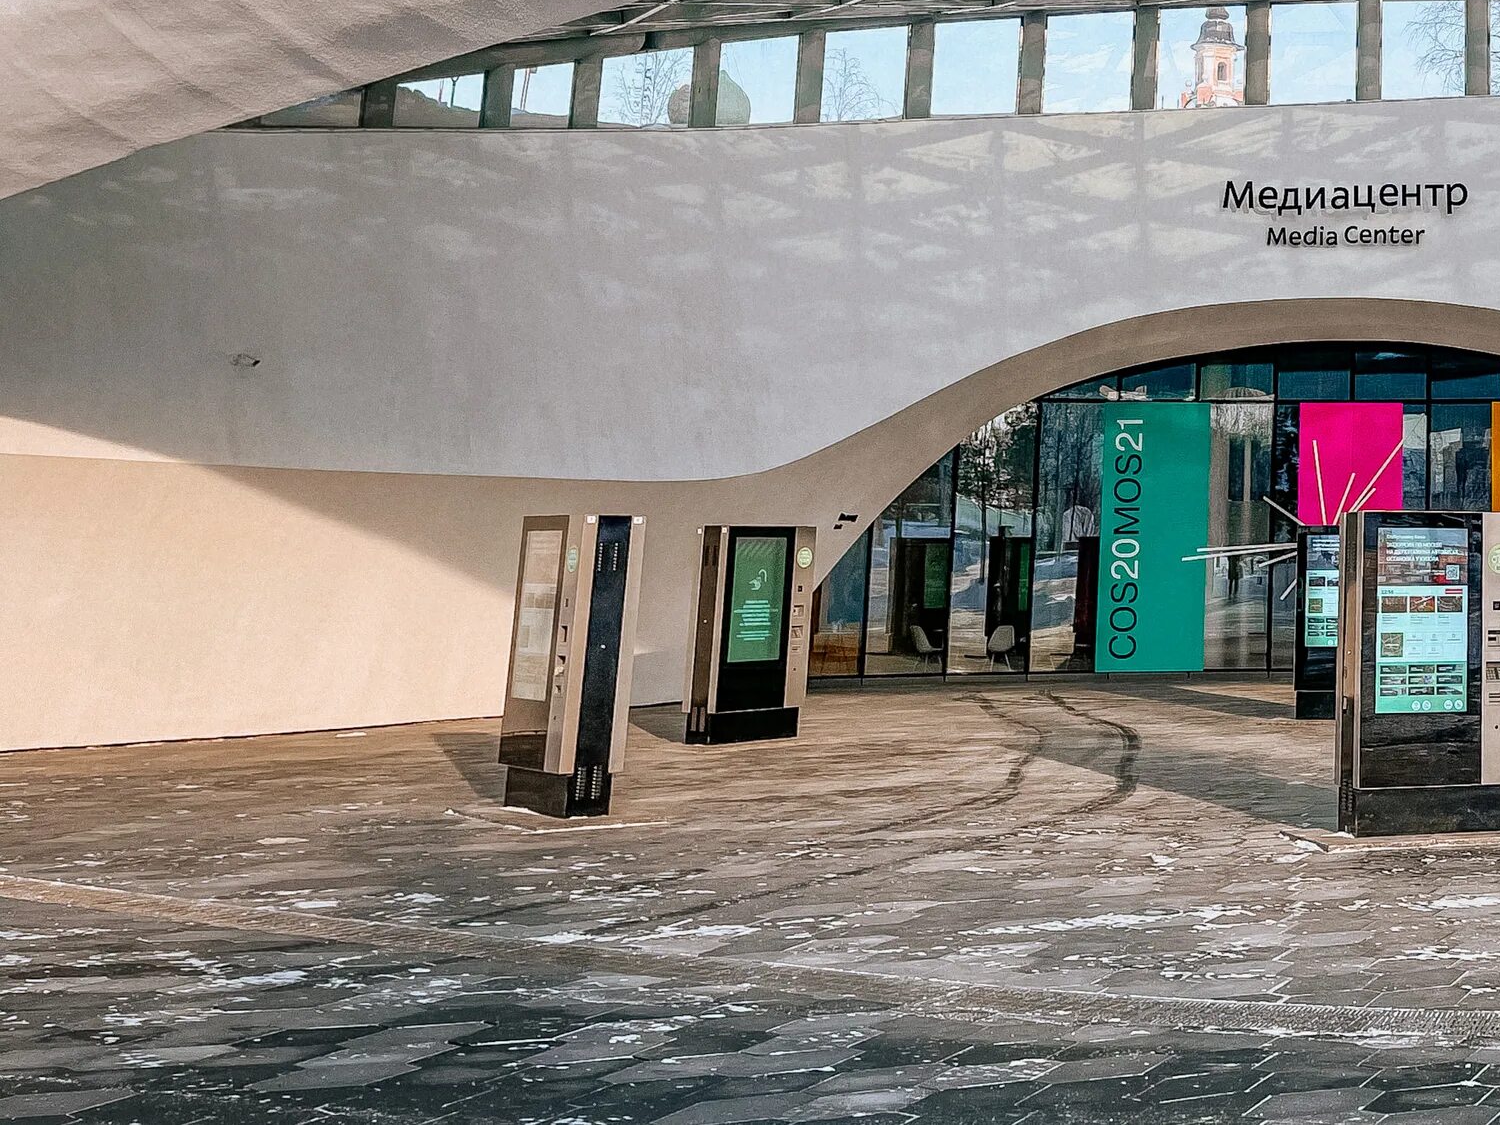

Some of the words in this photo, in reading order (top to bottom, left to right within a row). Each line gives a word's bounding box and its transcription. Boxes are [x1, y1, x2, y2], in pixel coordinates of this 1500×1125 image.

[1222, 180, 1469, 215] Медиацентр
[1266, 226, 1338, 246] Media
[1343, 225, 1426, 245] Center
[1108, 419, 1144, 660] COS20MOS21
